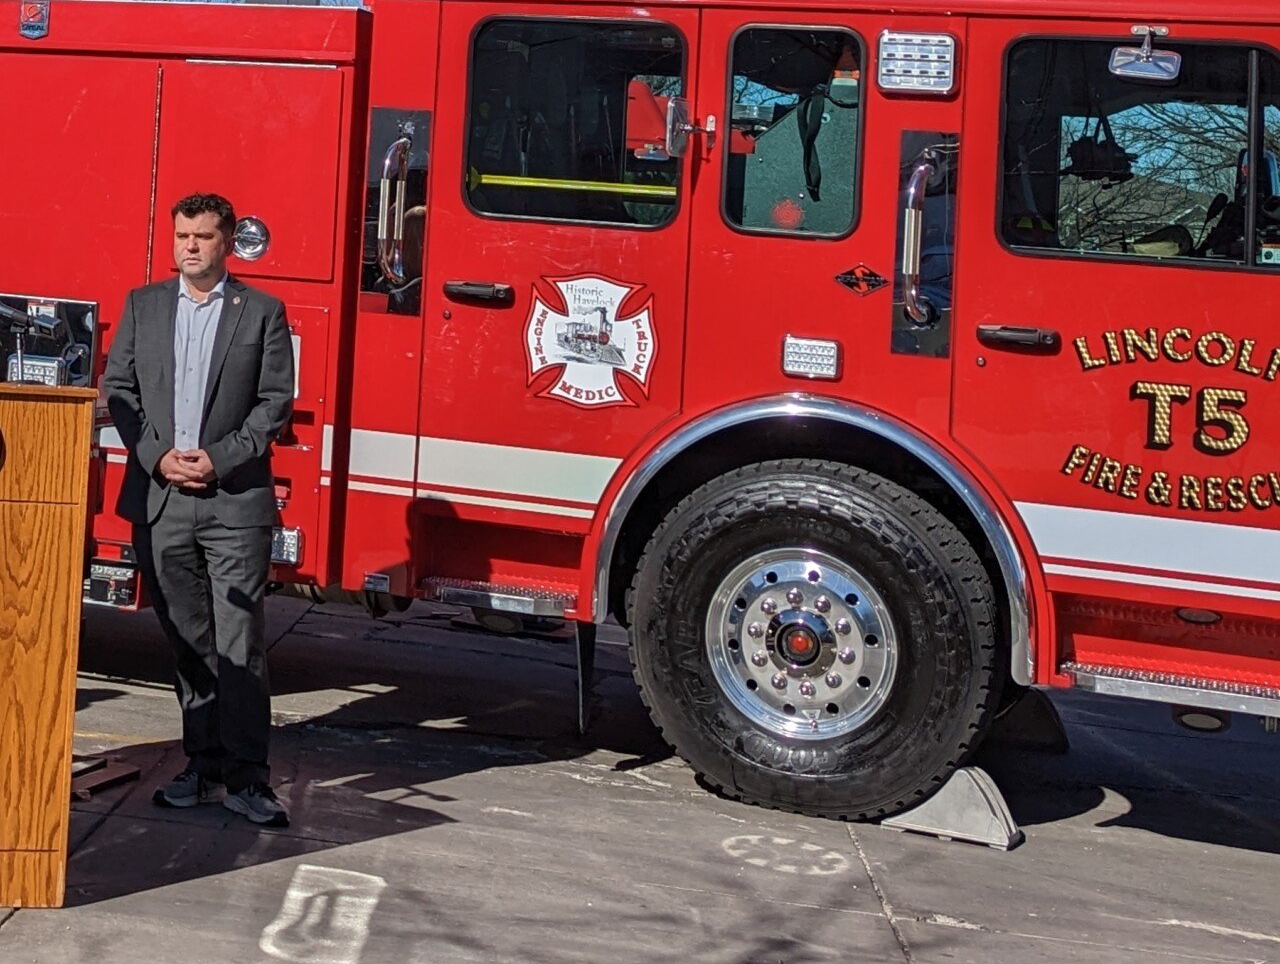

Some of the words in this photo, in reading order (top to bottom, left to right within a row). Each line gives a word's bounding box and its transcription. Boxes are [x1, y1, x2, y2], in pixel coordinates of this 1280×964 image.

[565, 284, 604, 296] Historic
[573, 295, 616, 307] Havelock
[533, 309, 549, 366] ENGINE
[630, 318, 649, 376] TRUCK
[558, 380, 617, 401] MEDIC
[1130, 380, 1250, 456] T5
[1062, 444, 1142, 498] FIRE
[1145, 470, 1173, 506] &
